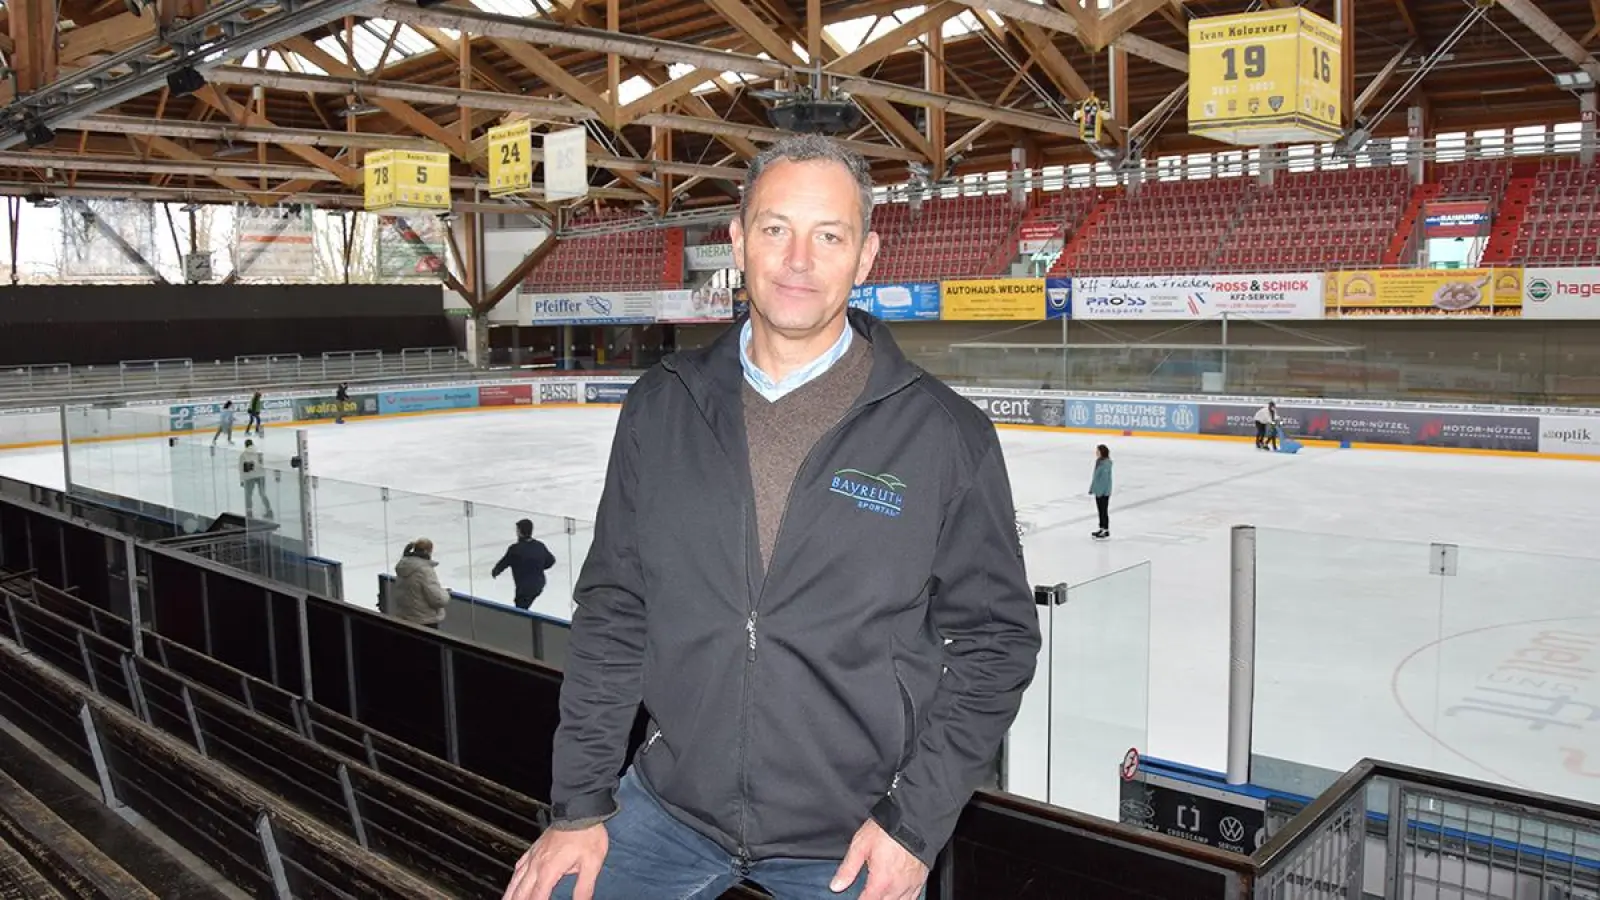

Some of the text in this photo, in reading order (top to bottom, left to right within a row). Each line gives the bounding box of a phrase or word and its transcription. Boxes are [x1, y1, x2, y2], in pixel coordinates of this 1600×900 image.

[1221, 45, 1266, 81] 19
[1313, 46, 1331, 84] 16
[501, 142, 520, 165] 24
[374, 166, 389, 186] 78
[416, 166, 428, 184] 5
[1250, 280, 1261, 291] &
[1263, 280, 1309, 291] SCHICK
[1229, 292, 1285, 301] KFZ-SERVICE
[534, 299, 582, 314] Pfeiffer
[305, 401, 358, 414] walraen
[991, 399, 1030, 416] cent
[1095, 403, 1167, 415] BAYREUTHER
[1094, 414, 1167, 428] BRAUHAUS
[831, 476, 903, 505] BAYREUTH
